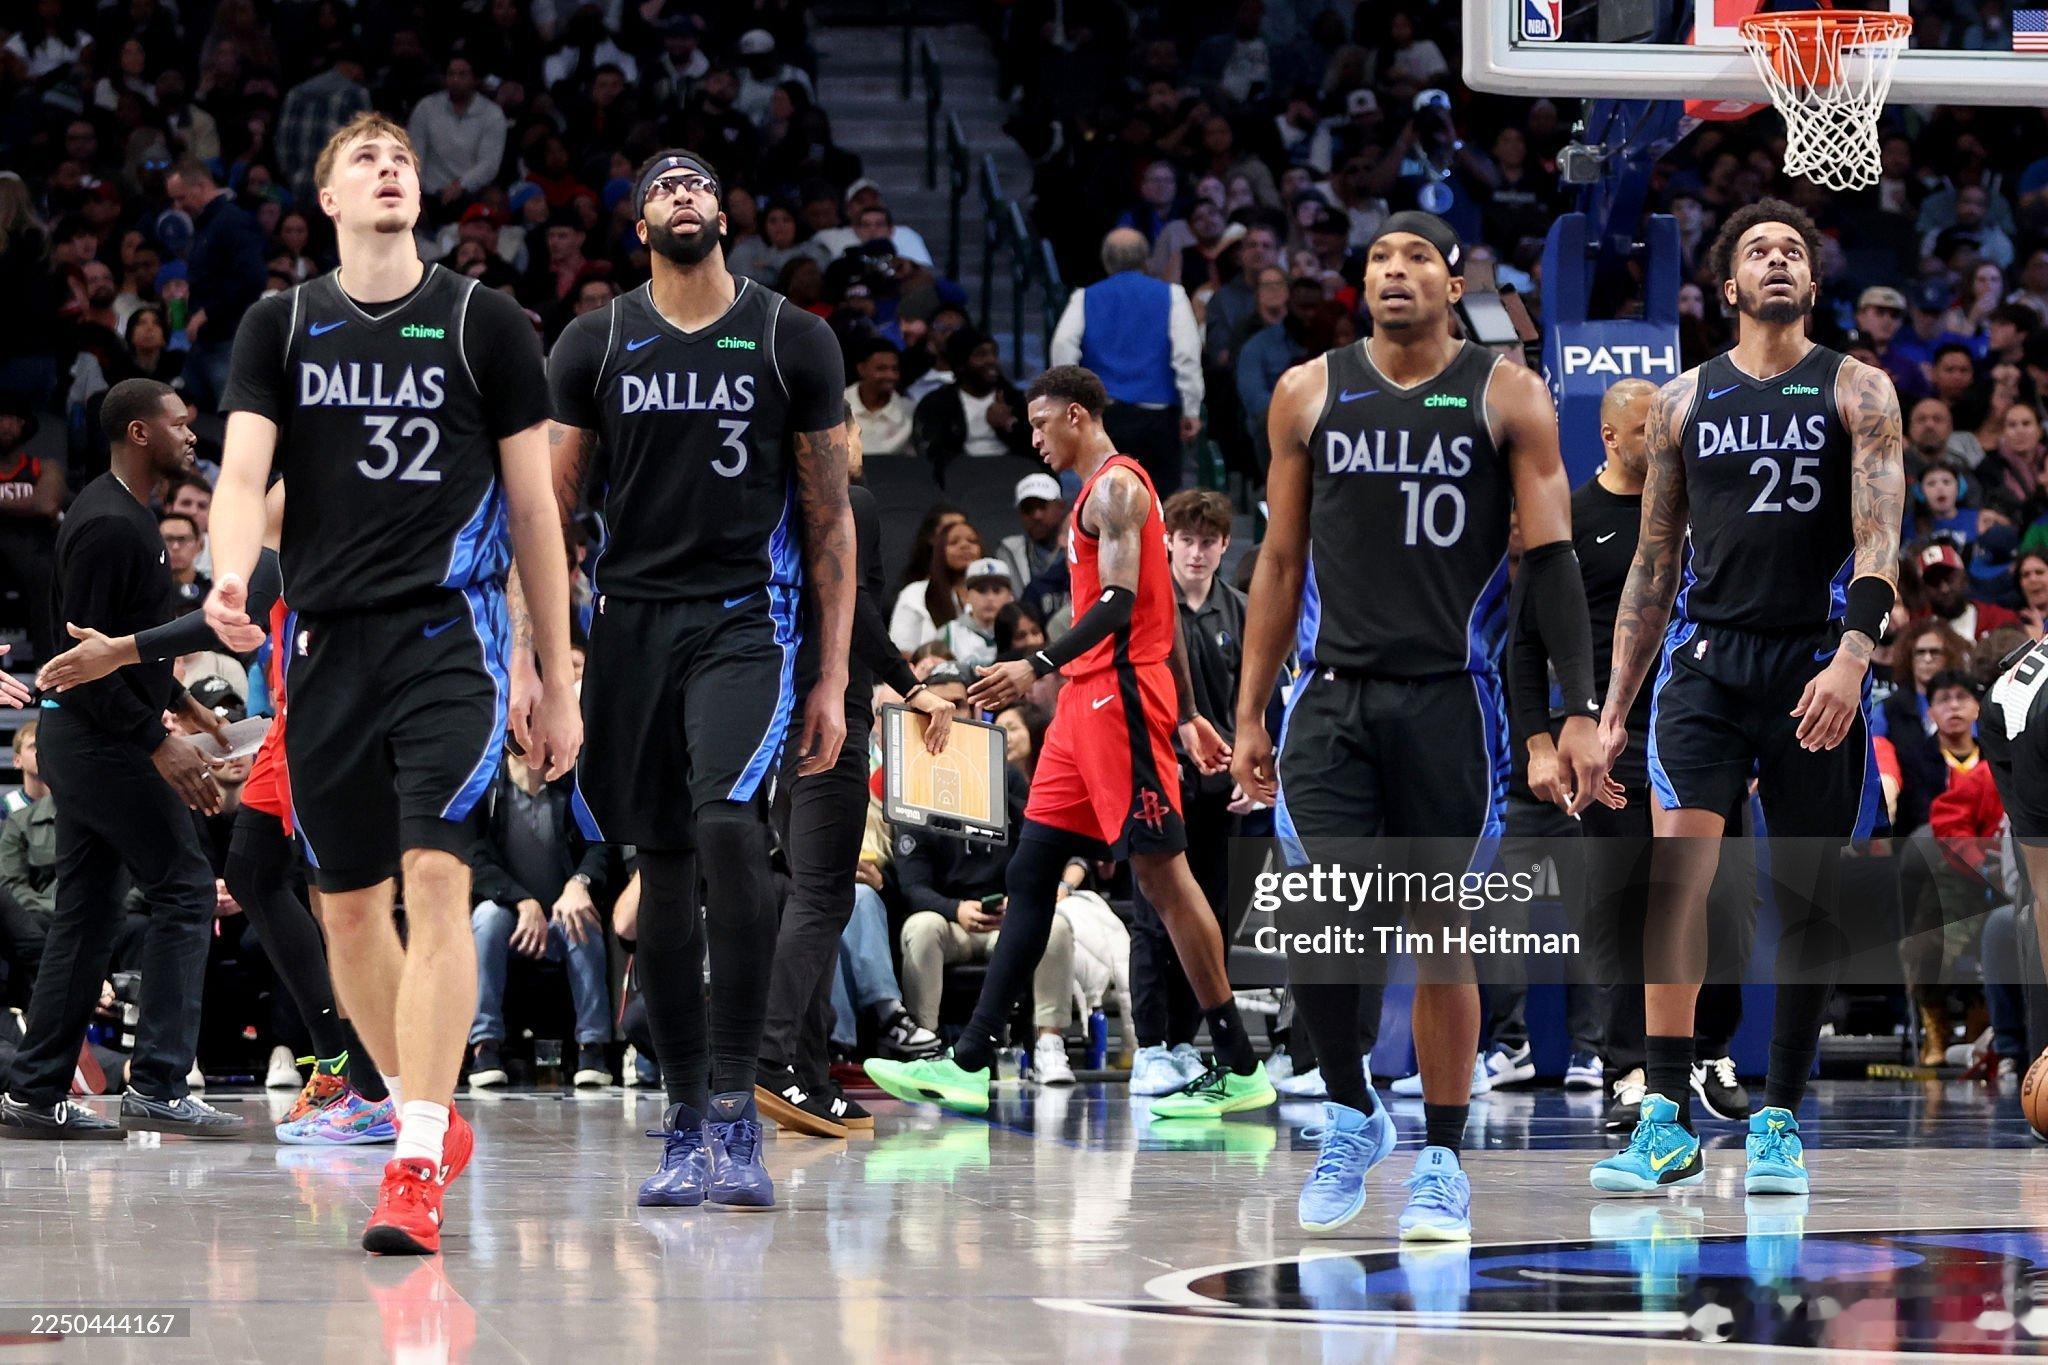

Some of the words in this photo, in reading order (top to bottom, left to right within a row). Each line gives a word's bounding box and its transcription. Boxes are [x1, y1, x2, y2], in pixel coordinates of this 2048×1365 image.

[1527, 19, 1548, 35] NBA
[400, 324, 445, 340] chime
[716, 336, 756, 351] chime
[1563, 345, 1676, 375] PATH
[300, 361, 445, 409] DALLAS
[620, 372, 755, 414] DALLAS
[1424, 393, 1468, 409] chime
[1781, 383, 1819, 395] chime
[356, 415, 443, 483] 32
[711, 420, 750, 478] 3
[1325, 430, 1473, 476] DALLAS
[1697, 413, 1826, 458] DALLAS
[1747, 457, 1821, 514] 25
[1399, 481, 1466, 547] 10
